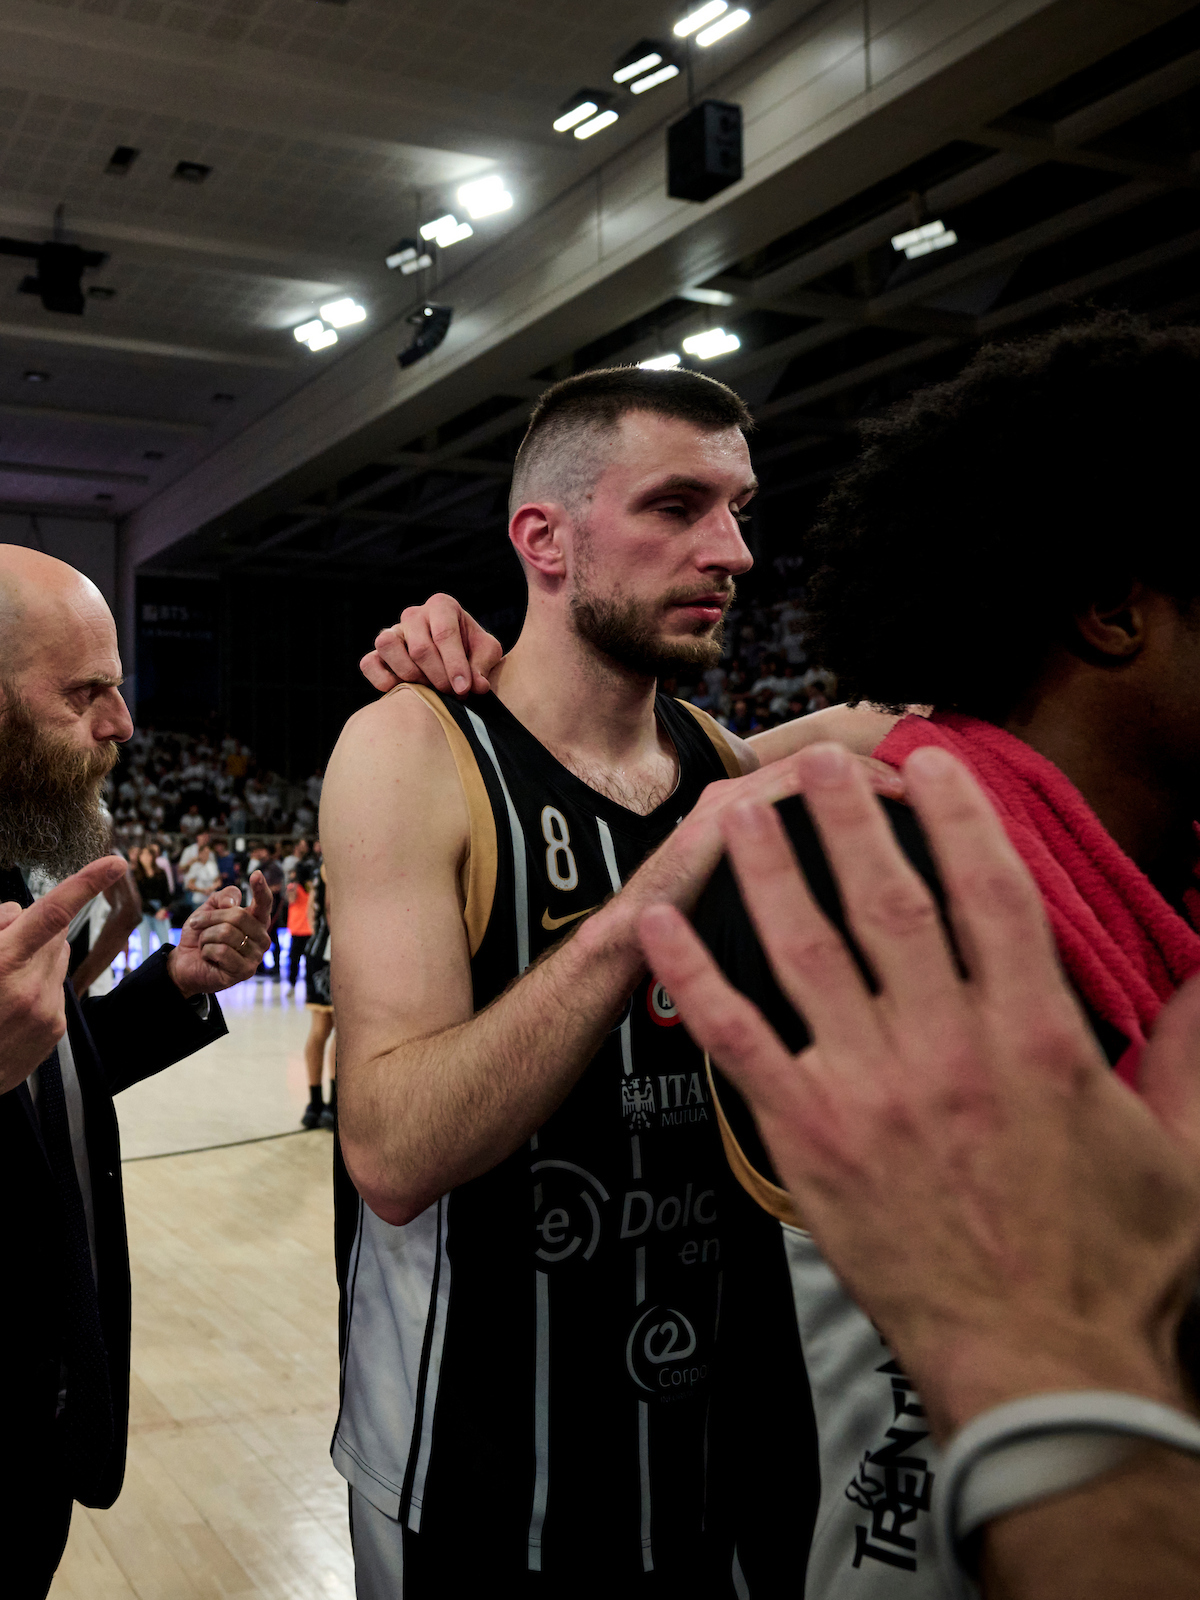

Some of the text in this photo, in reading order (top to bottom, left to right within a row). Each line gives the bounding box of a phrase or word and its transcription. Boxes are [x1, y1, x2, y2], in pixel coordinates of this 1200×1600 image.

[540, 805, 579, 891] 8
[658, 1072, 708, 1109] ITA
[661, 1107, 709, 1127] MUTUA
